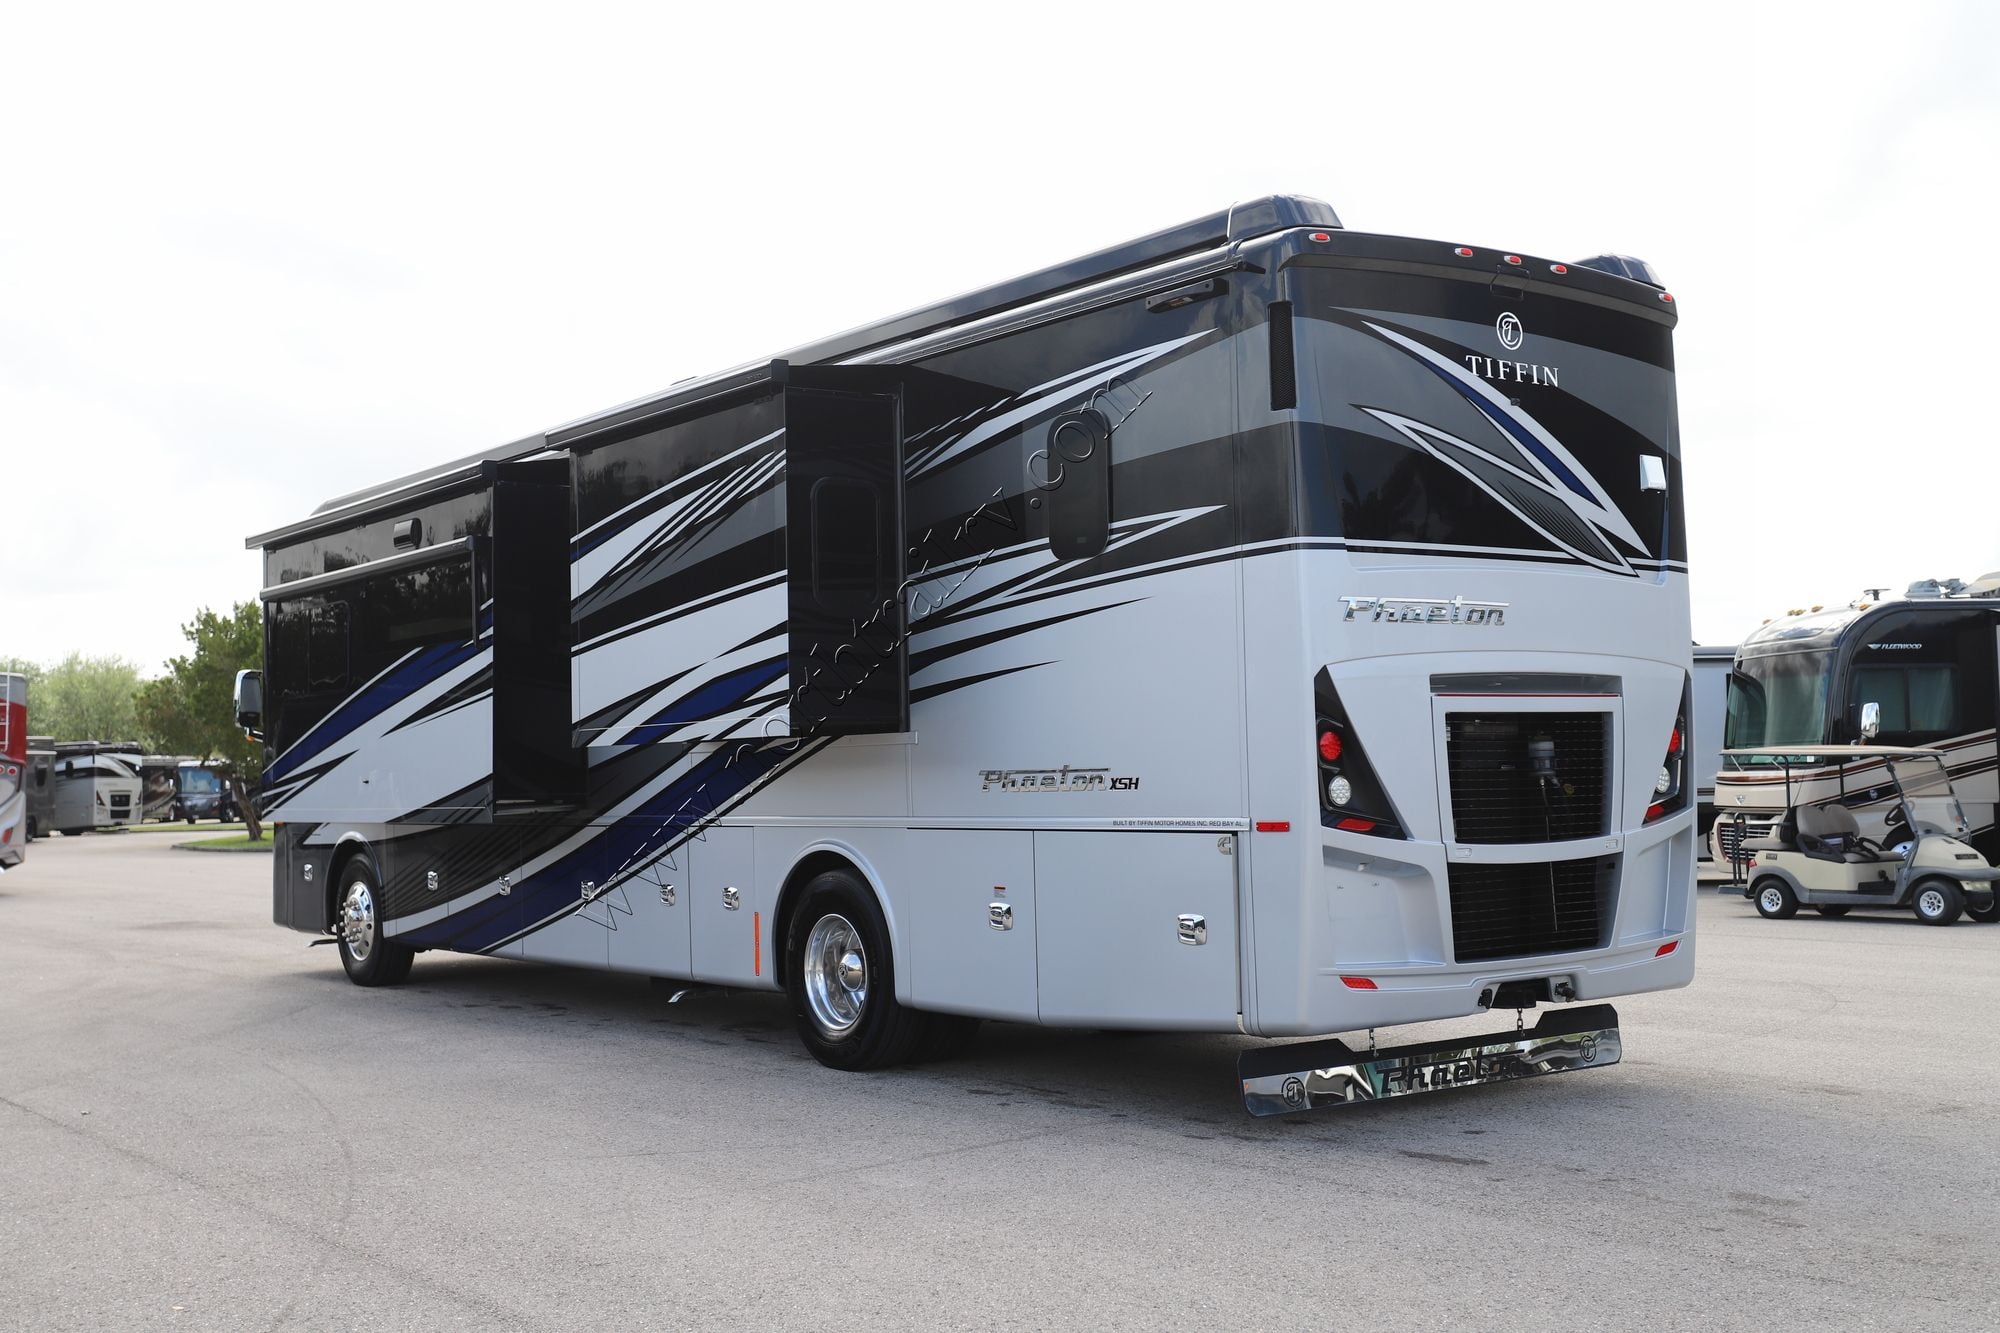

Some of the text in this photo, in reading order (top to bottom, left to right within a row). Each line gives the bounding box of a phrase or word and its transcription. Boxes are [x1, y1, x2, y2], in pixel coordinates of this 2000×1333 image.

[1465, 354, 1559, 387] TIFFIN
[1338, 595, 1510, 626] Phaeton
[979, 764, 1140, 793] Phaeton XSH
